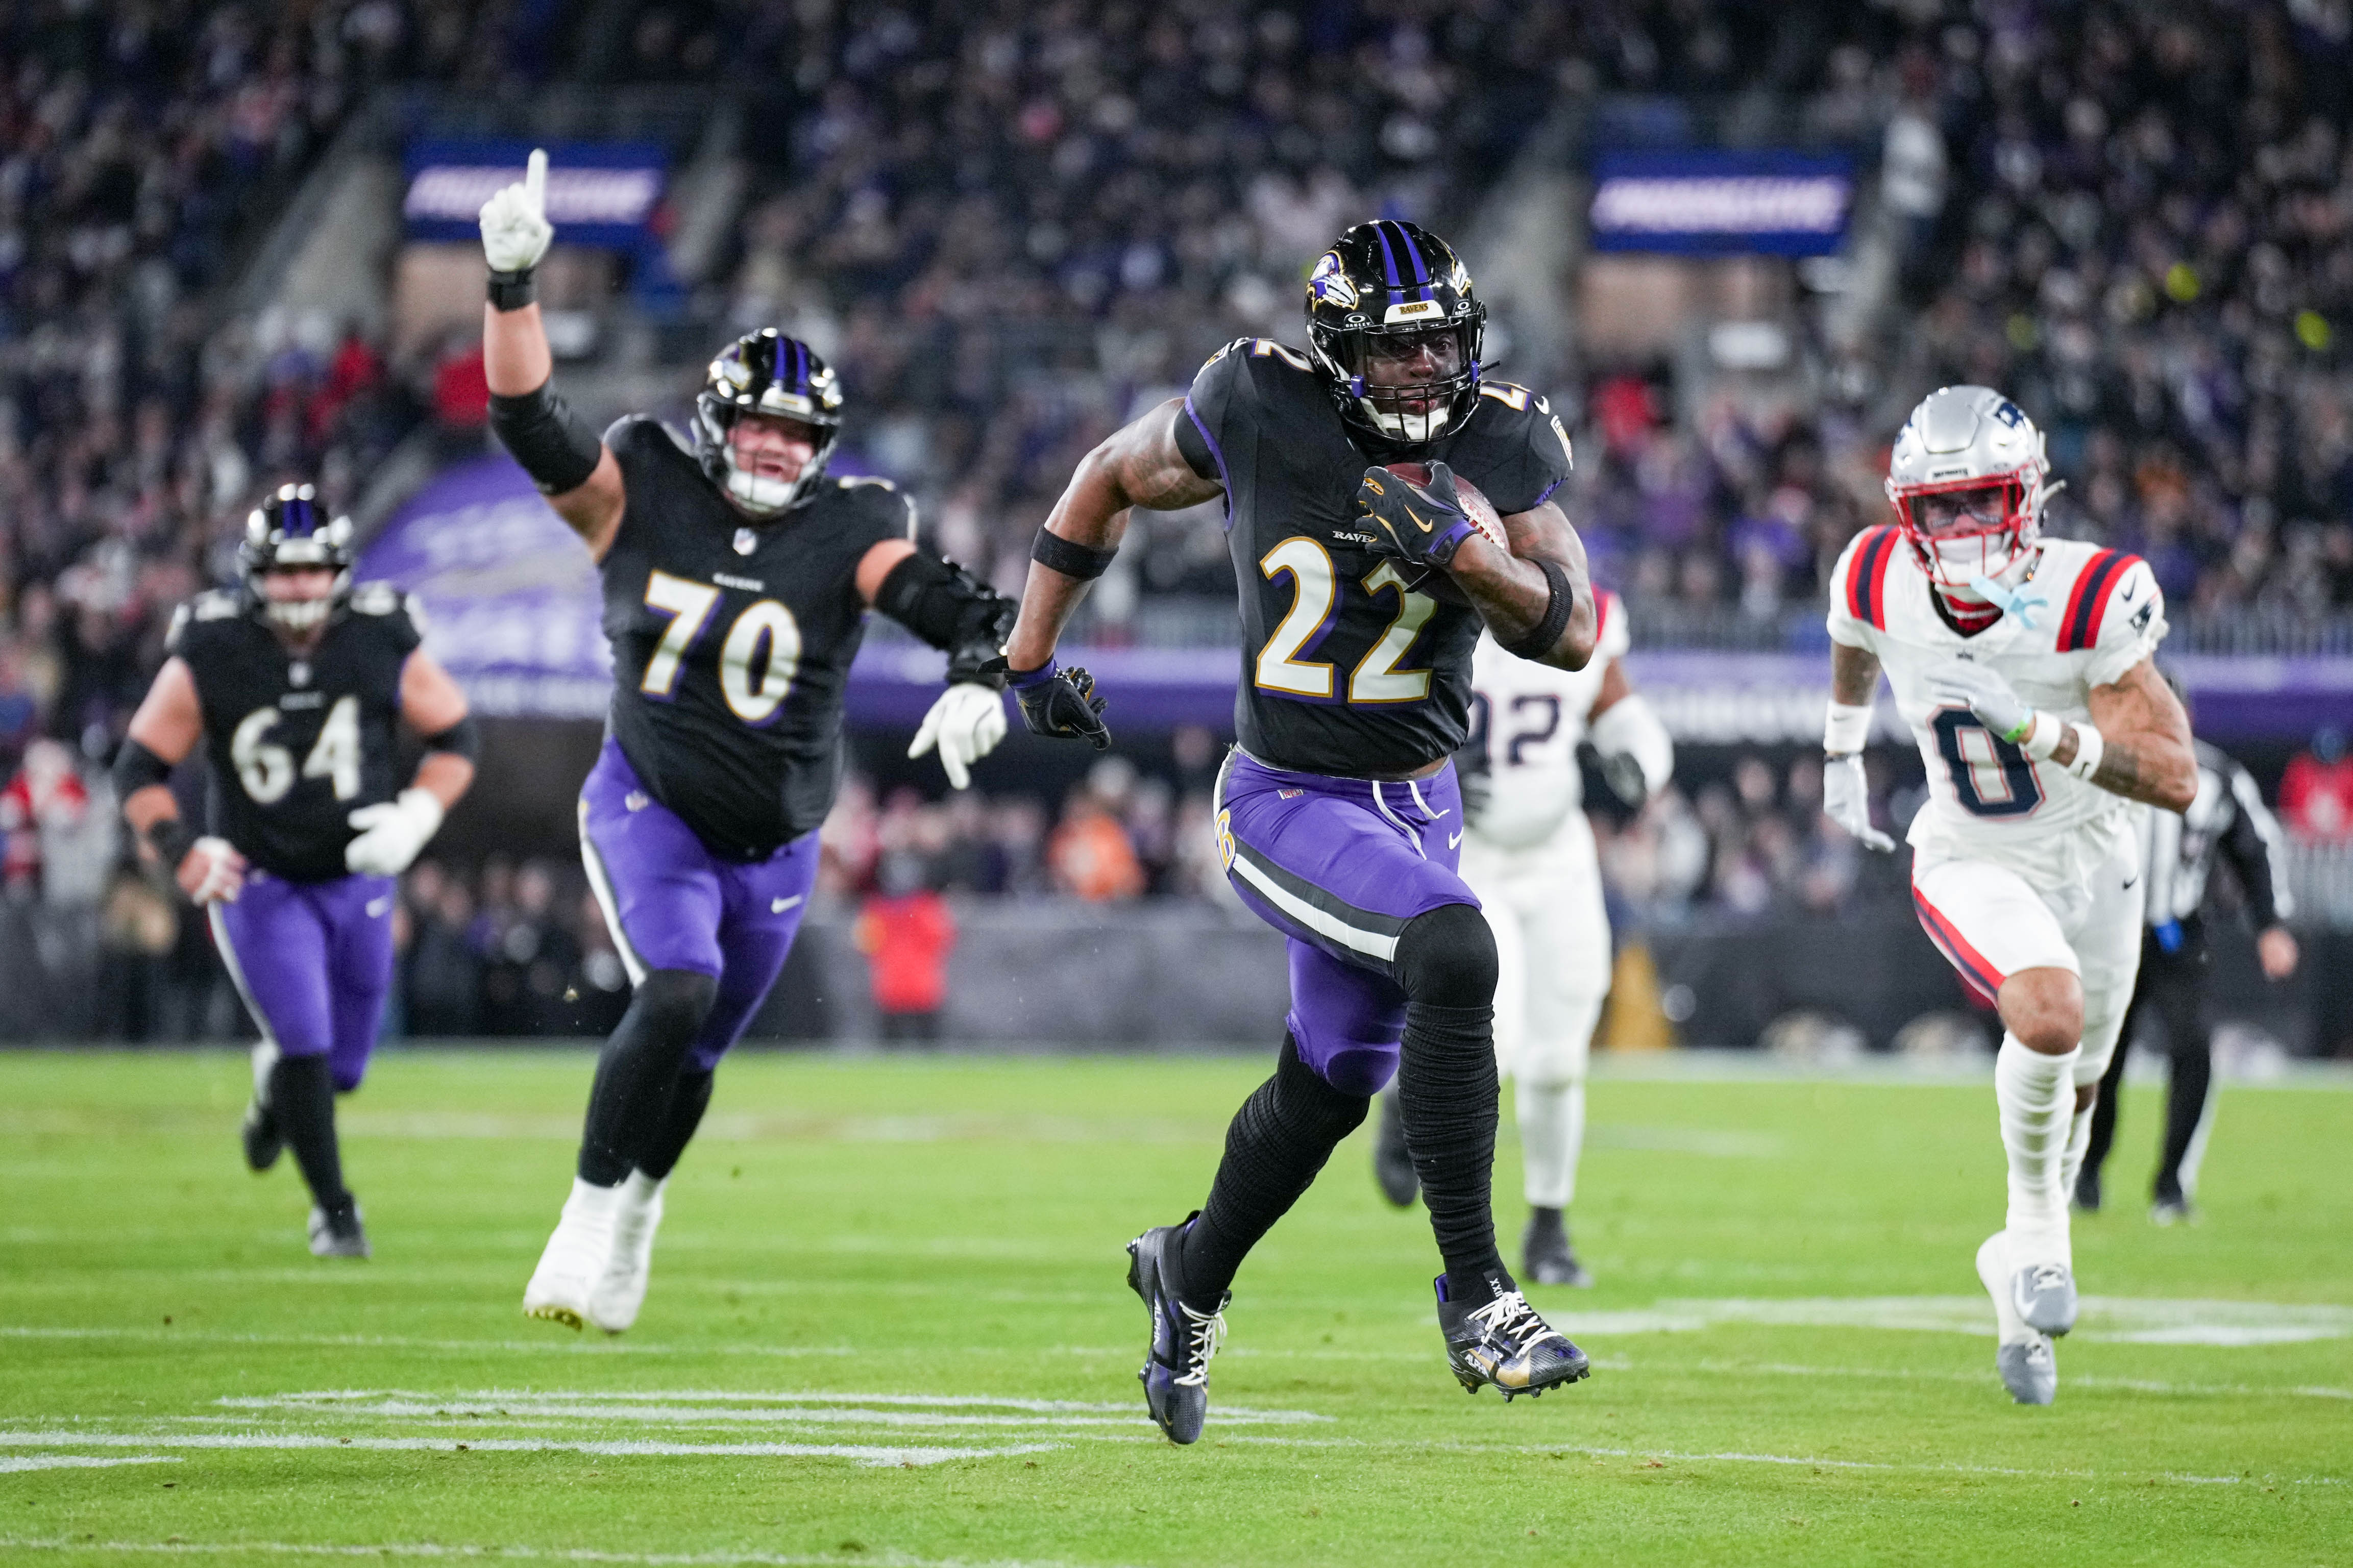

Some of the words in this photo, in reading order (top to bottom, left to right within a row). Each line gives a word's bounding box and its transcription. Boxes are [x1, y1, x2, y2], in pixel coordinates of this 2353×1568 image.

[1399, 303, 1429, 315] RAVENS
[1333, 530, 1372, 542] RAVE
[641, 568, 802, 721] 70
[1255, 536, 1437, 704] 22
[231, 694, 360, 805] 64
[1926, 704, 2046, 822] 0
[1153, 1299, 1161, 1346] ALPHA
